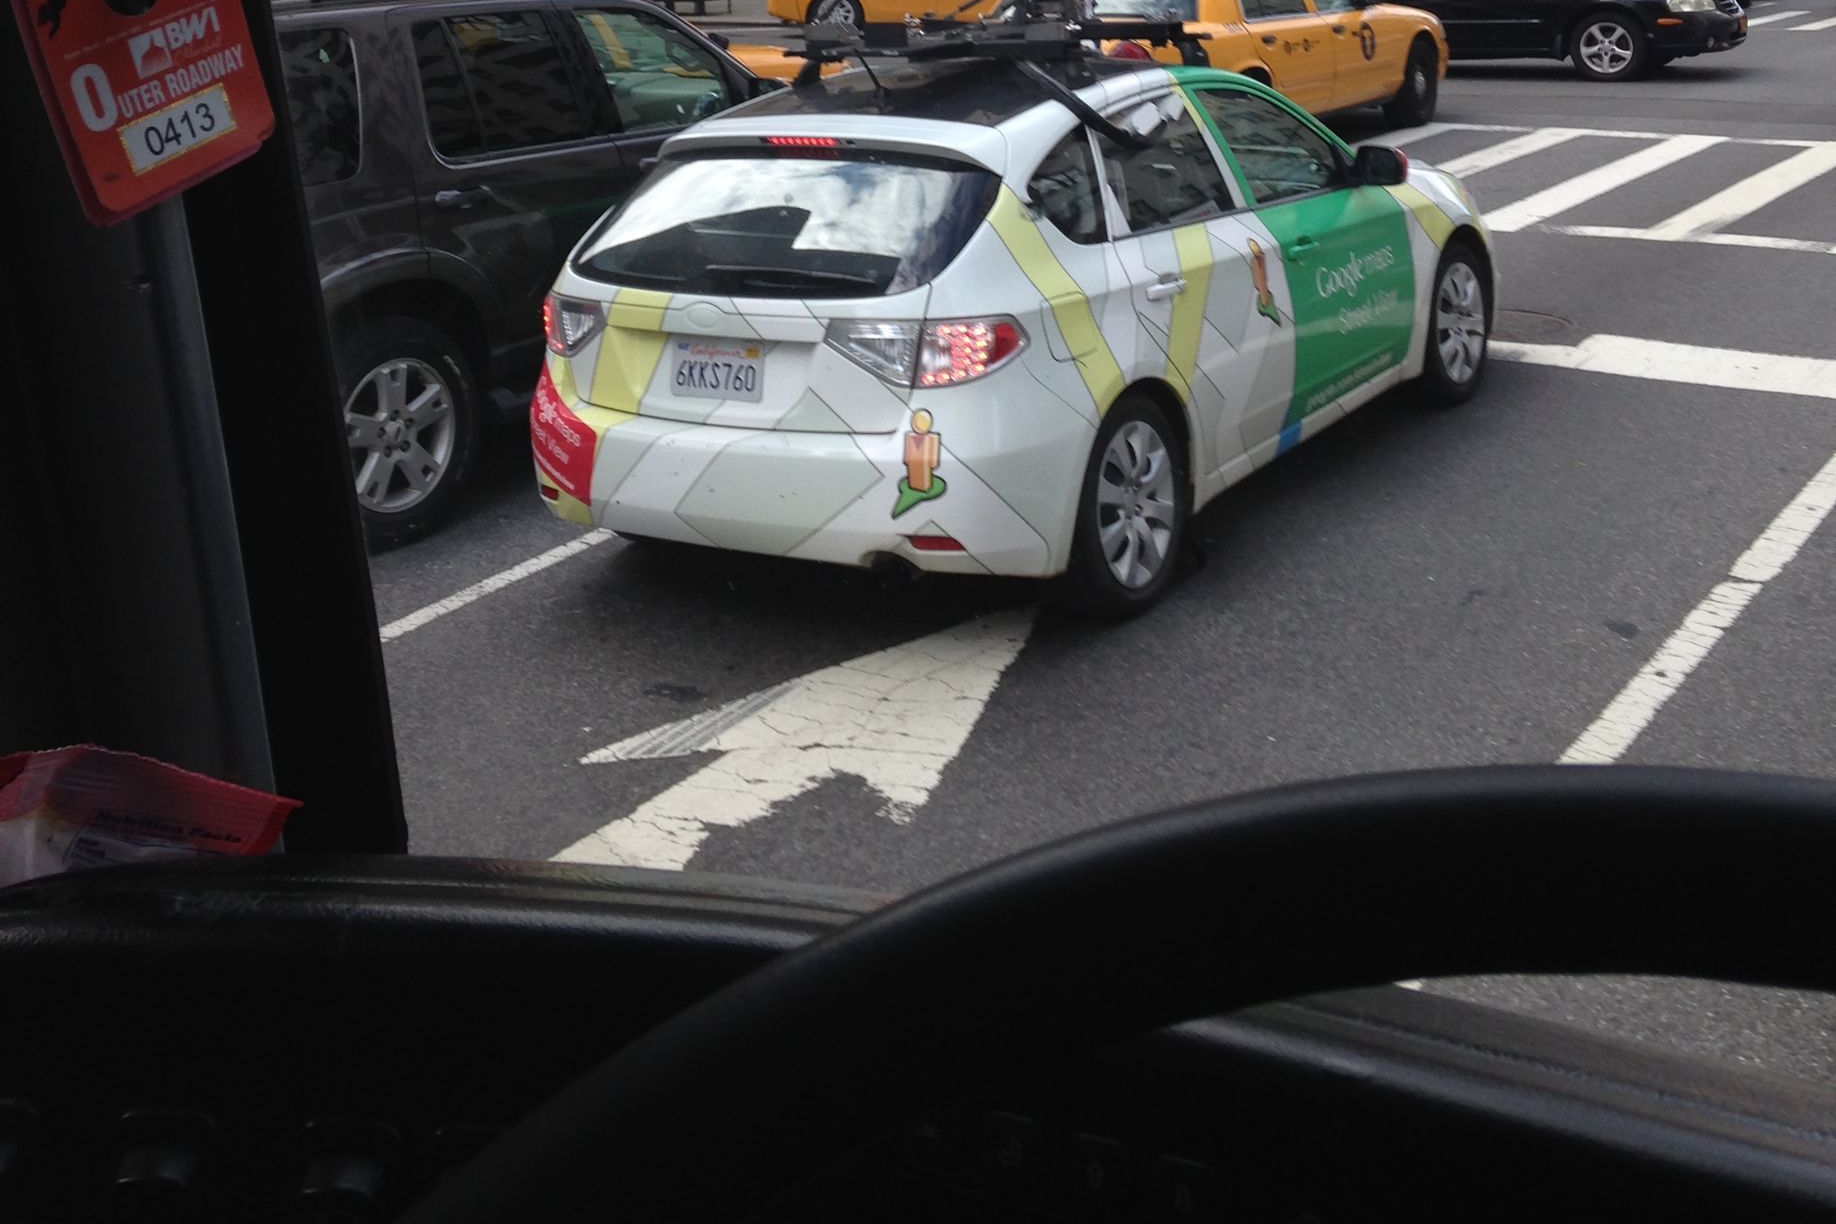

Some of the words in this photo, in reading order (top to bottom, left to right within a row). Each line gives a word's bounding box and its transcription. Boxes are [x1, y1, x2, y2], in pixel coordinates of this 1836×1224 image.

[165, 6, 220, 50] BWI
[165, 44, 245, 98] ROADWAY
[144, 102, 216, 156] 0413
[676, 360, 756, 392] 6KKS760
[94, 810, 184, 834] Nutrition
[188, 827, 242, 843] Facts
